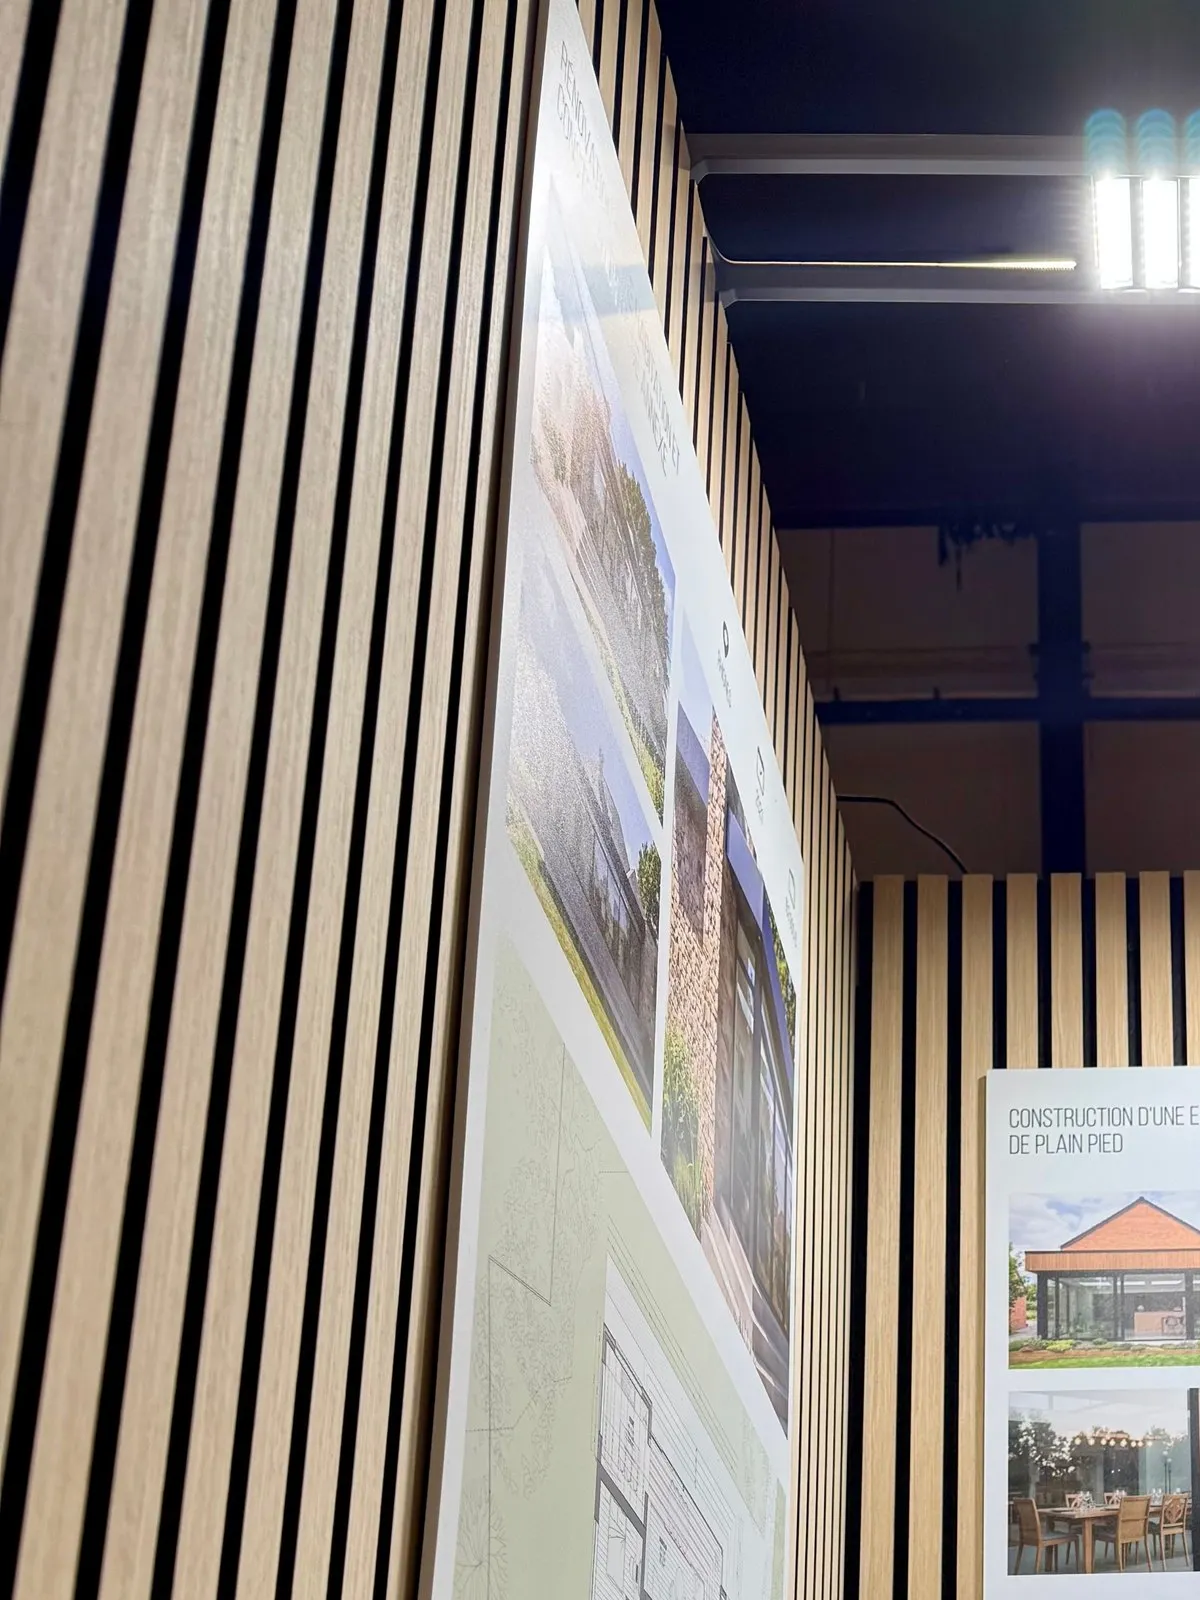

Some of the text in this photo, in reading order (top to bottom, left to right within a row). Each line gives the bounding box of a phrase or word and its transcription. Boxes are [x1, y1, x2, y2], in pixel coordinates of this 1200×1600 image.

[1009, 1106, 1133, 1129] CONSTRUCTION
[1138, 1105, 1185, 1127] D'UNE
[1009, 1132, 1124, 1155] DE PLAIN PIED
